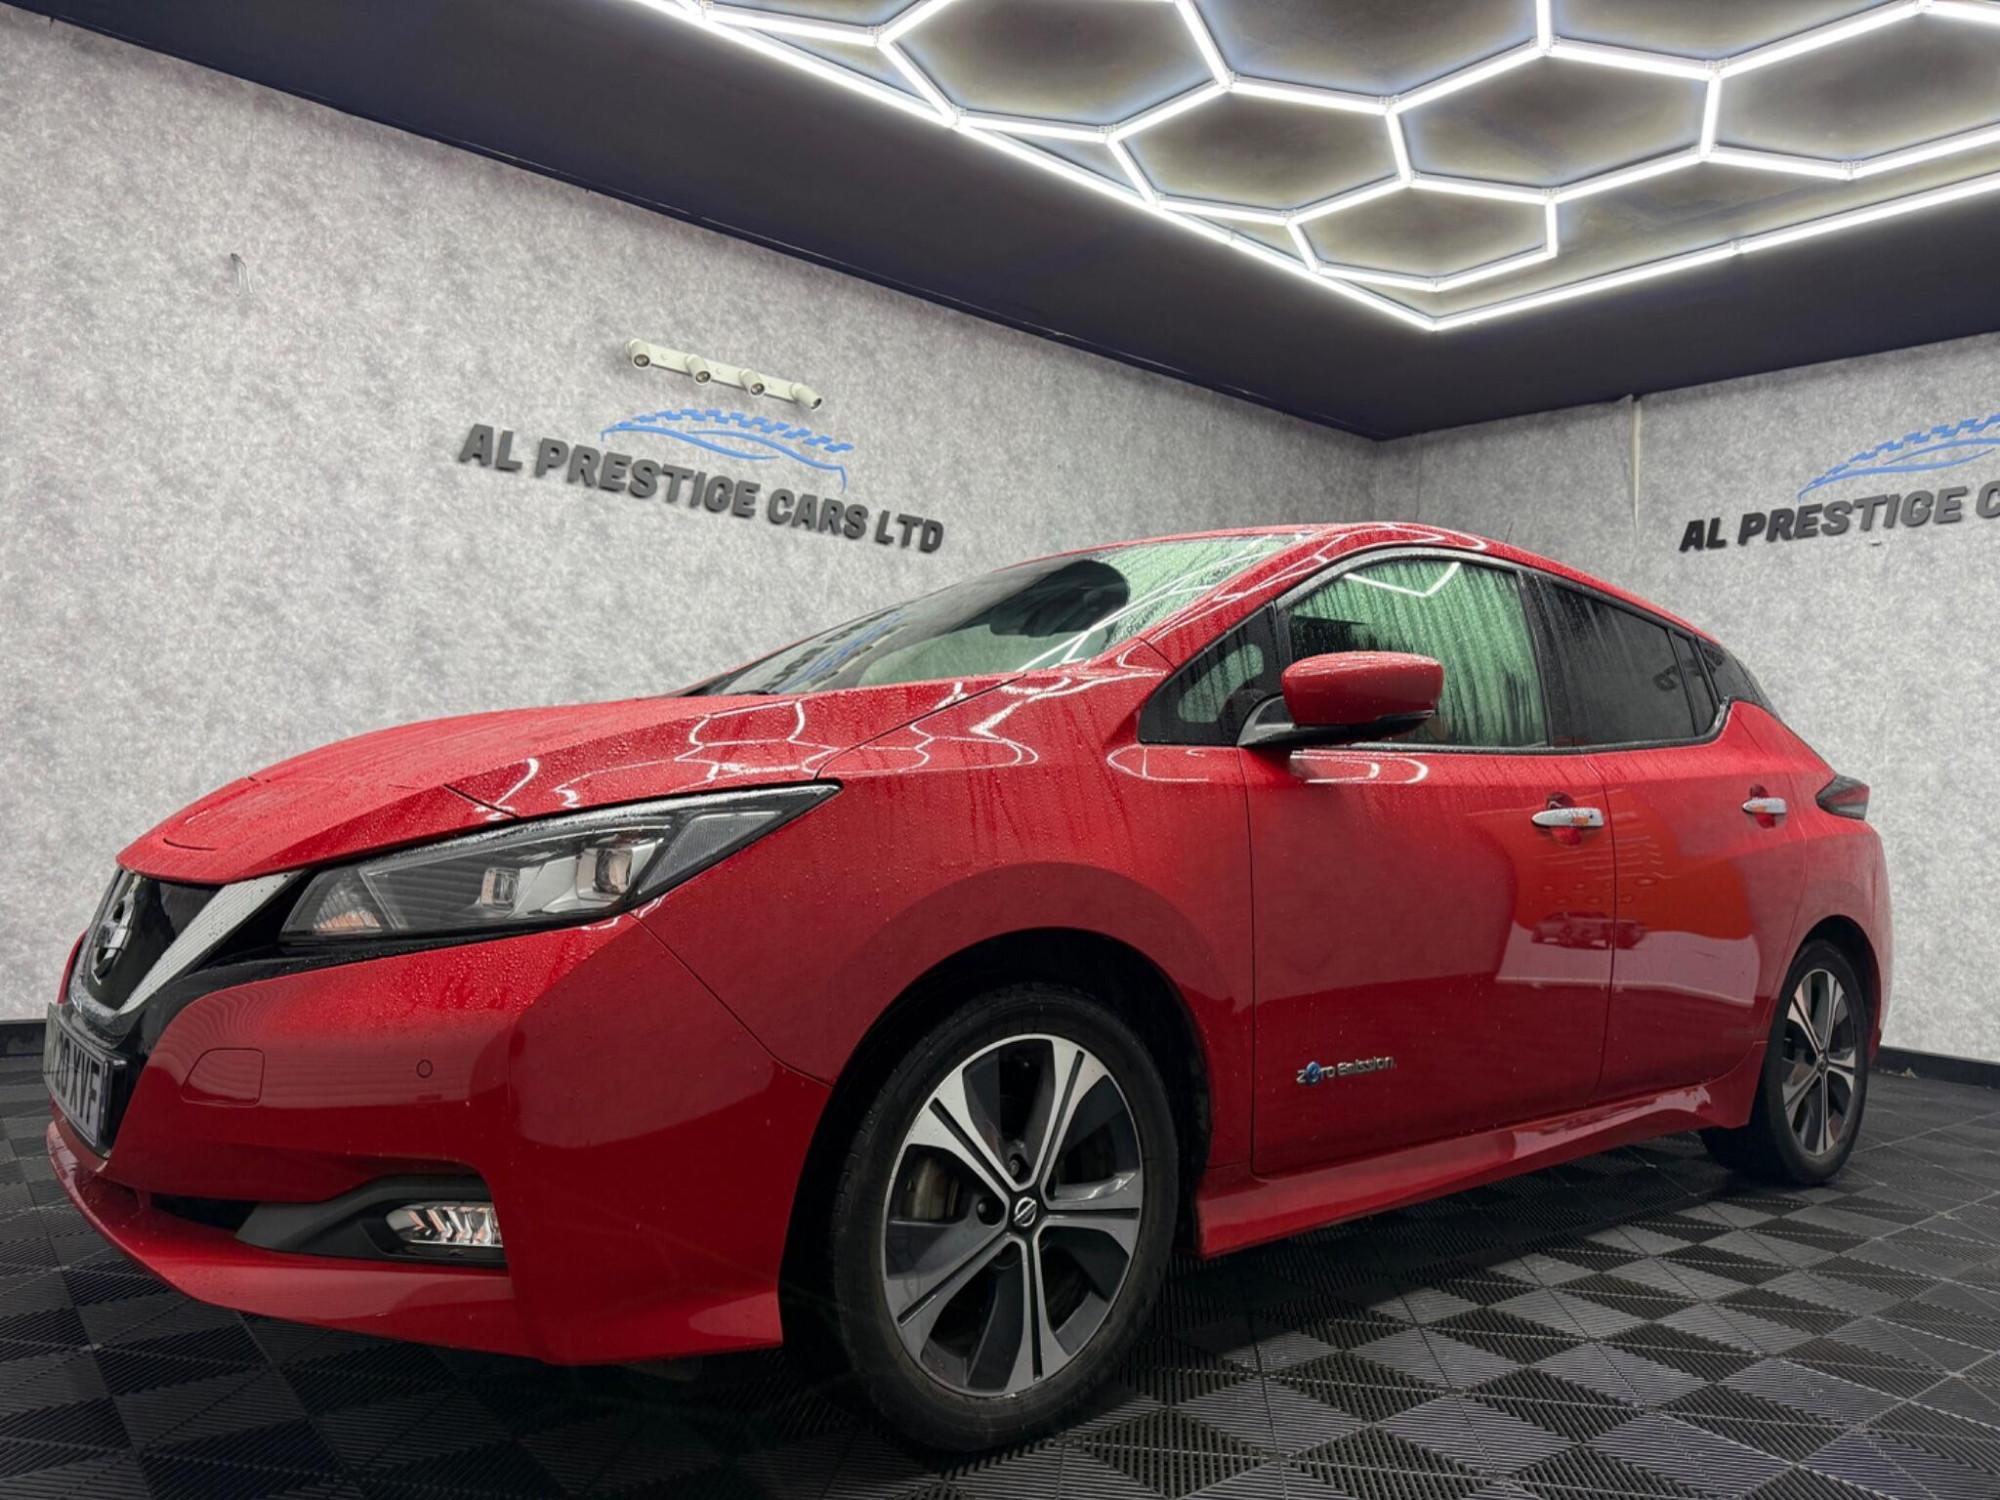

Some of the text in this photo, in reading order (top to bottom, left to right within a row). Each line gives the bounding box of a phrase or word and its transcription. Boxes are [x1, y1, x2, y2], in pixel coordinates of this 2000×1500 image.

[458, 423, 945, 554] AL PRESTIGE CARS LTD
[1678, 516, 1727, 552] AL
[1737, 486, 1968, 546] PRESTIGE
[1338, 1057, 1394, 1076] Emission
